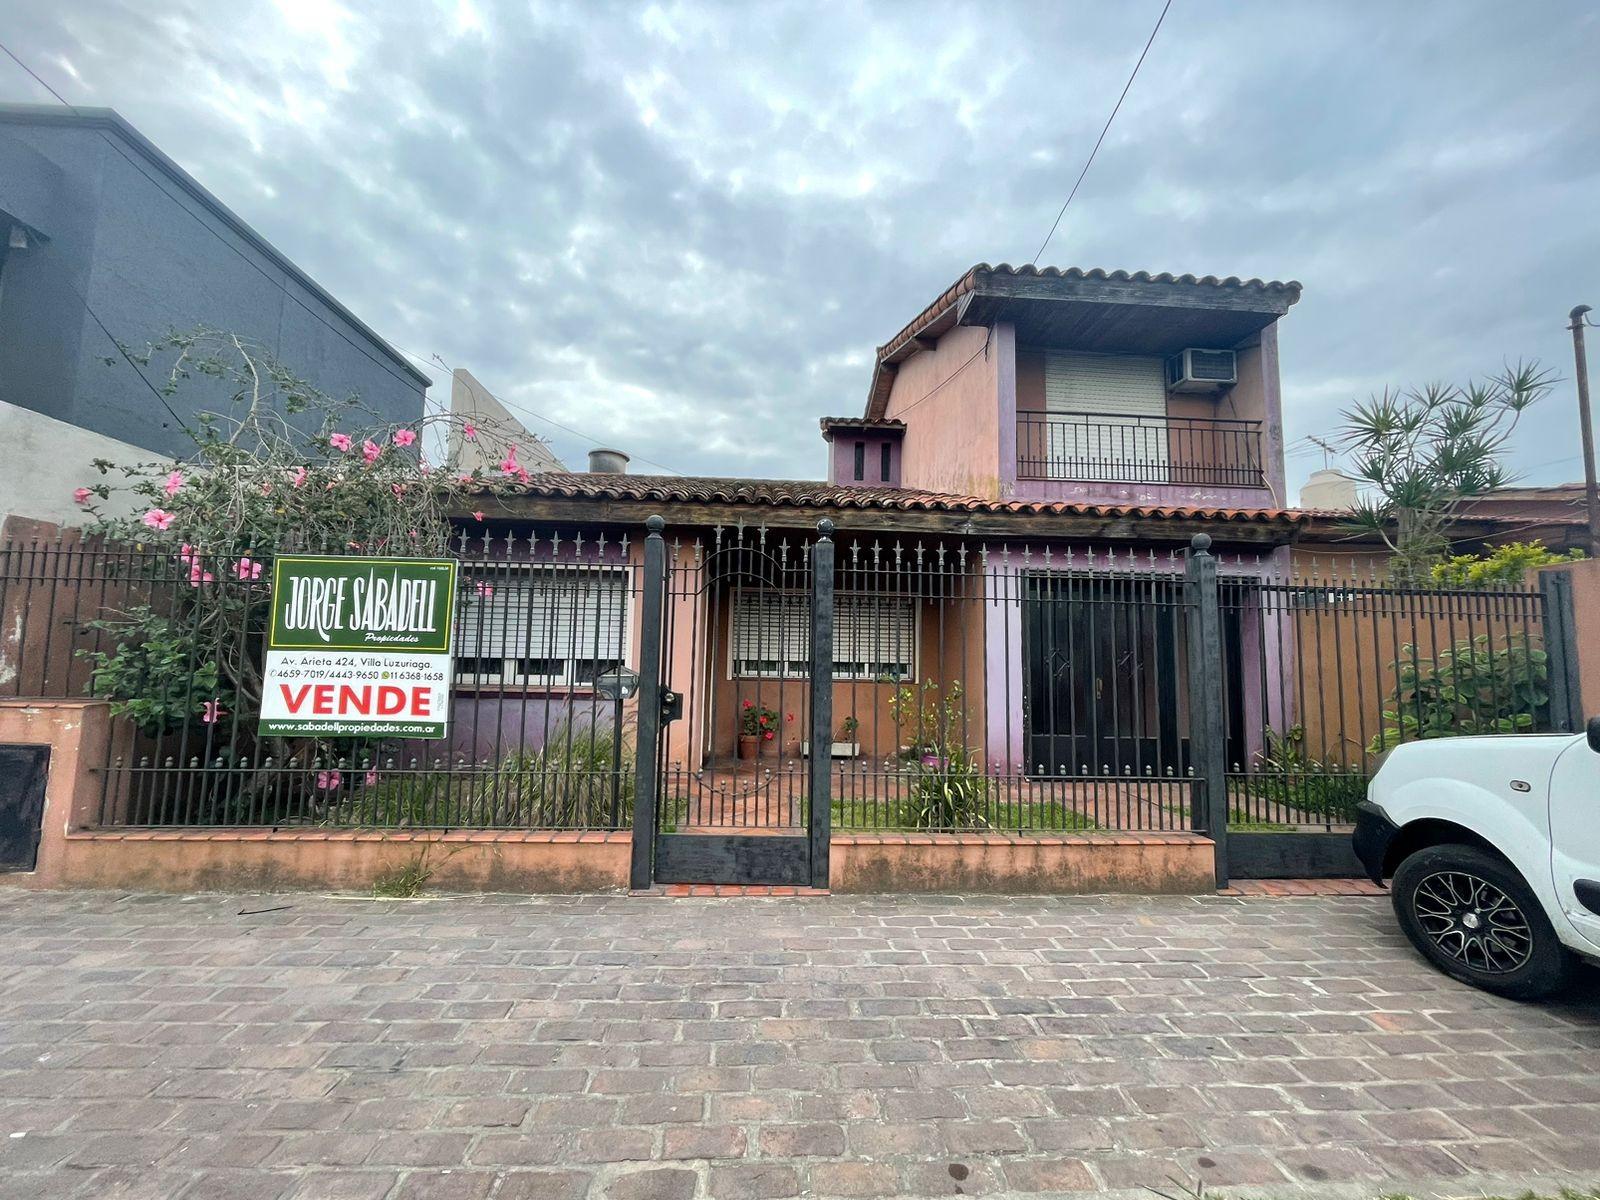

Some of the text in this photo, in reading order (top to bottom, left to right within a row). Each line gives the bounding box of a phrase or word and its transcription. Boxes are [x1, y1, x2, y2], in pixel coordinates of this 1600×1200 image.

[285, 567, 437, 642] JORGE SABADELL
[364, 632, 420, 644] Propiedades
[281, 656, 433, 671] Av. Arieta 424, Villa Luzuriaga.
[280, 684, 432, 717] VENDE
[268, 722, 436, 735] www.sabadellpropiedades.com.ar
